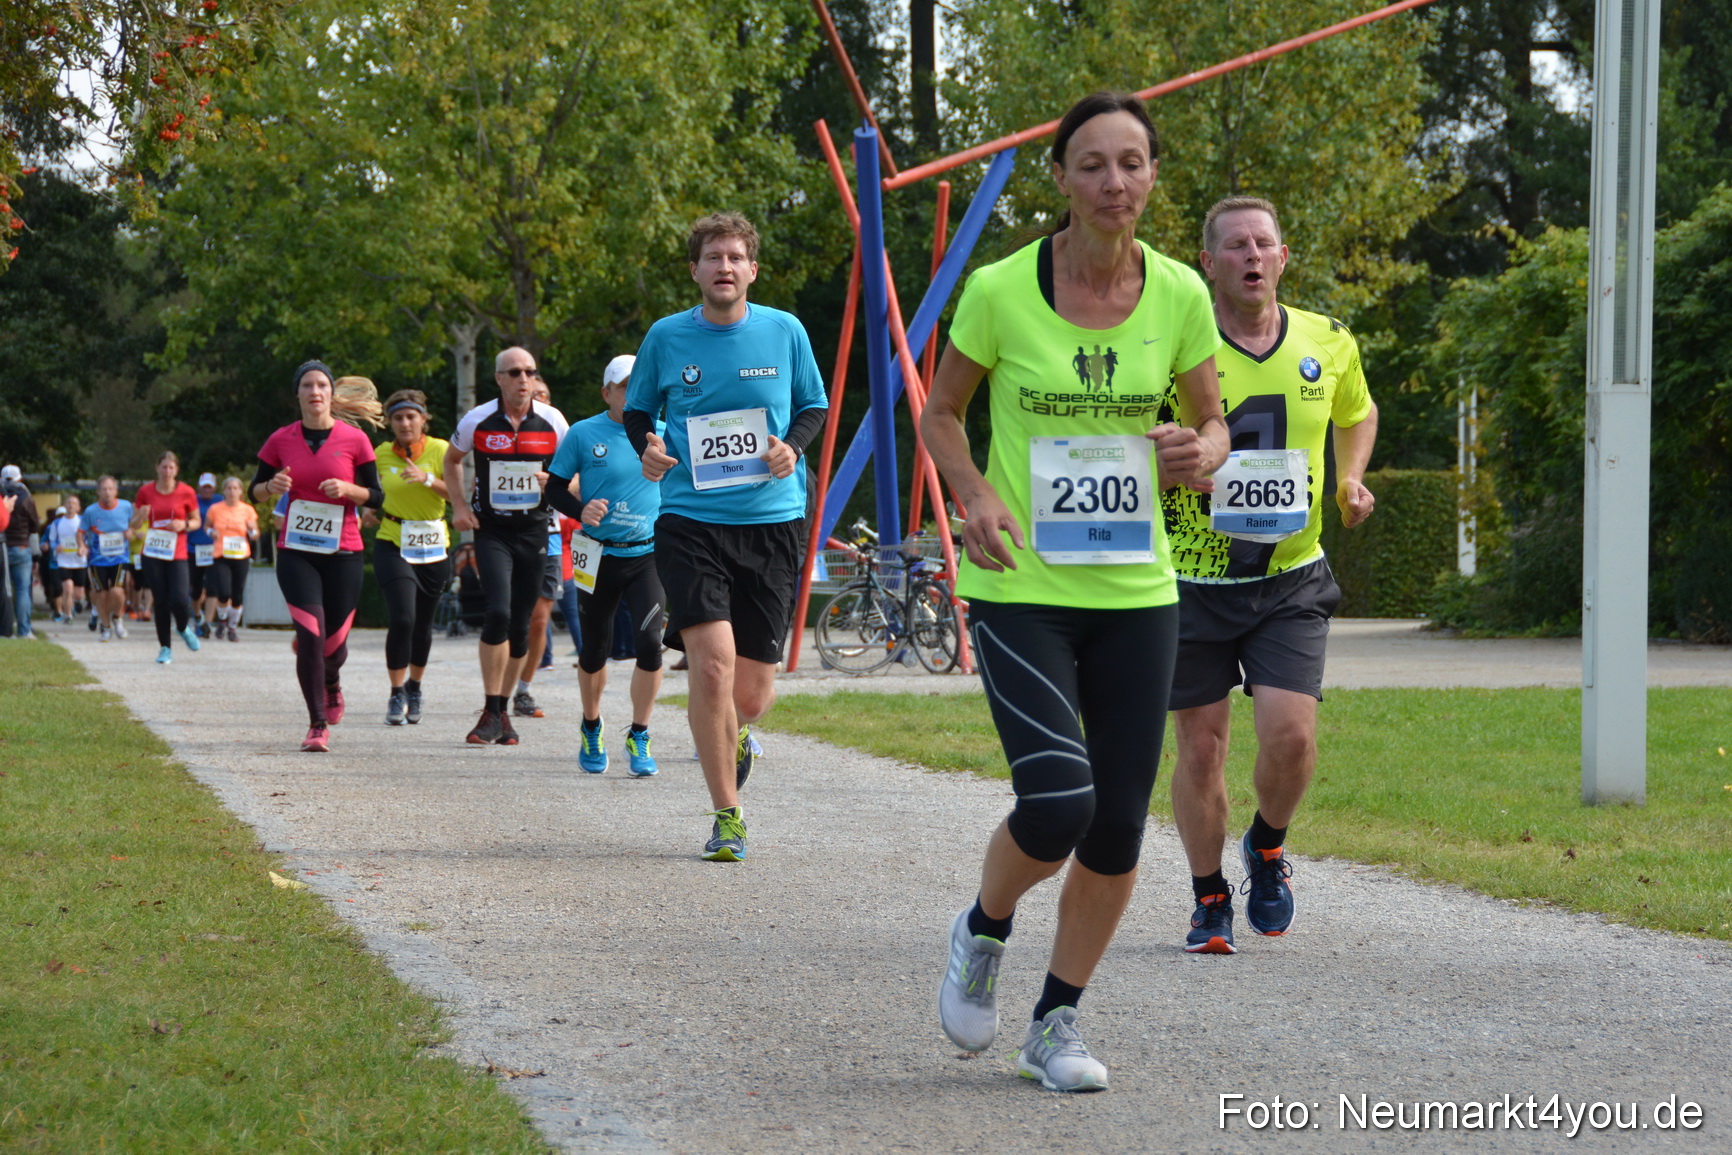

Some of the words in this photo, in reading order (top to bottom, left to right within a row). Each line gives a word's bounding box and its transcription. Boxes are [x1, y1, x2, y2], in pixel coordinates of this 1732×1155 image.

[739, 367, 778, 377] BOCK
[1019, 386, 1040, 400] SC
[1300, 385, 1325, 397] Partl
[701, 432, 758, 460] 2539
[1082, 447, 1125, 460] BOCK
[721, 465, 744, 474] Thore
[497, 476, 532, 490] 2141
[1051, 475, 1139, 514] 2303
[1226, 479, 1295, 508] 2663
[296, 515, 333, 534] 2274
[1246, 517, 1278, 528] Rainer
[408, 532, 439, 546] 2432
[1088, 527, 1111, 541] Rita
[149, 537, 171, 549] 2012
